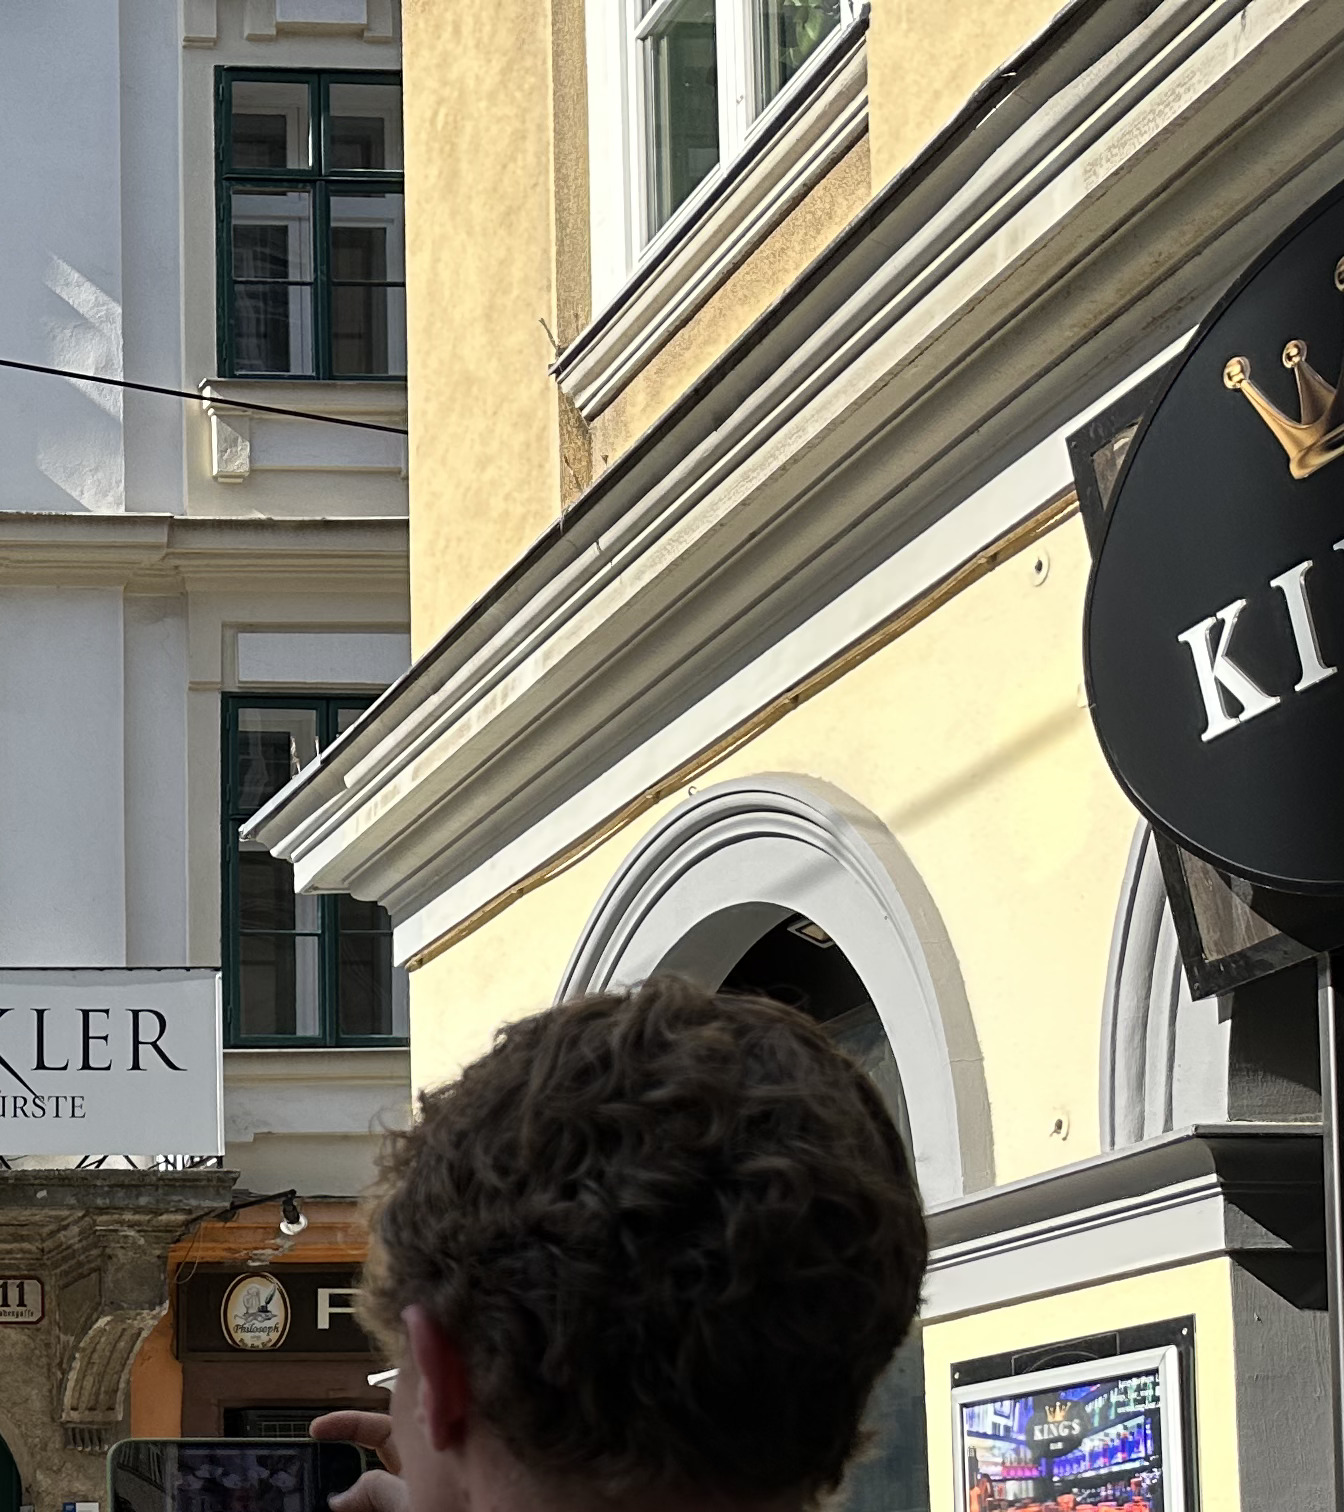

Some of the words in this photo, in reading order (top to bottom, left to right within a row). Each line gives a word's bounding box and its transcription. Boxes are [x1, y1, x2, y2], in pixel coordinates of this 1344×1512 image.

[1178, 538, 1344, 744] KI
[0, 1280, 28, 1308] 11
[232, 1321, 280, 1337] Philosoph
